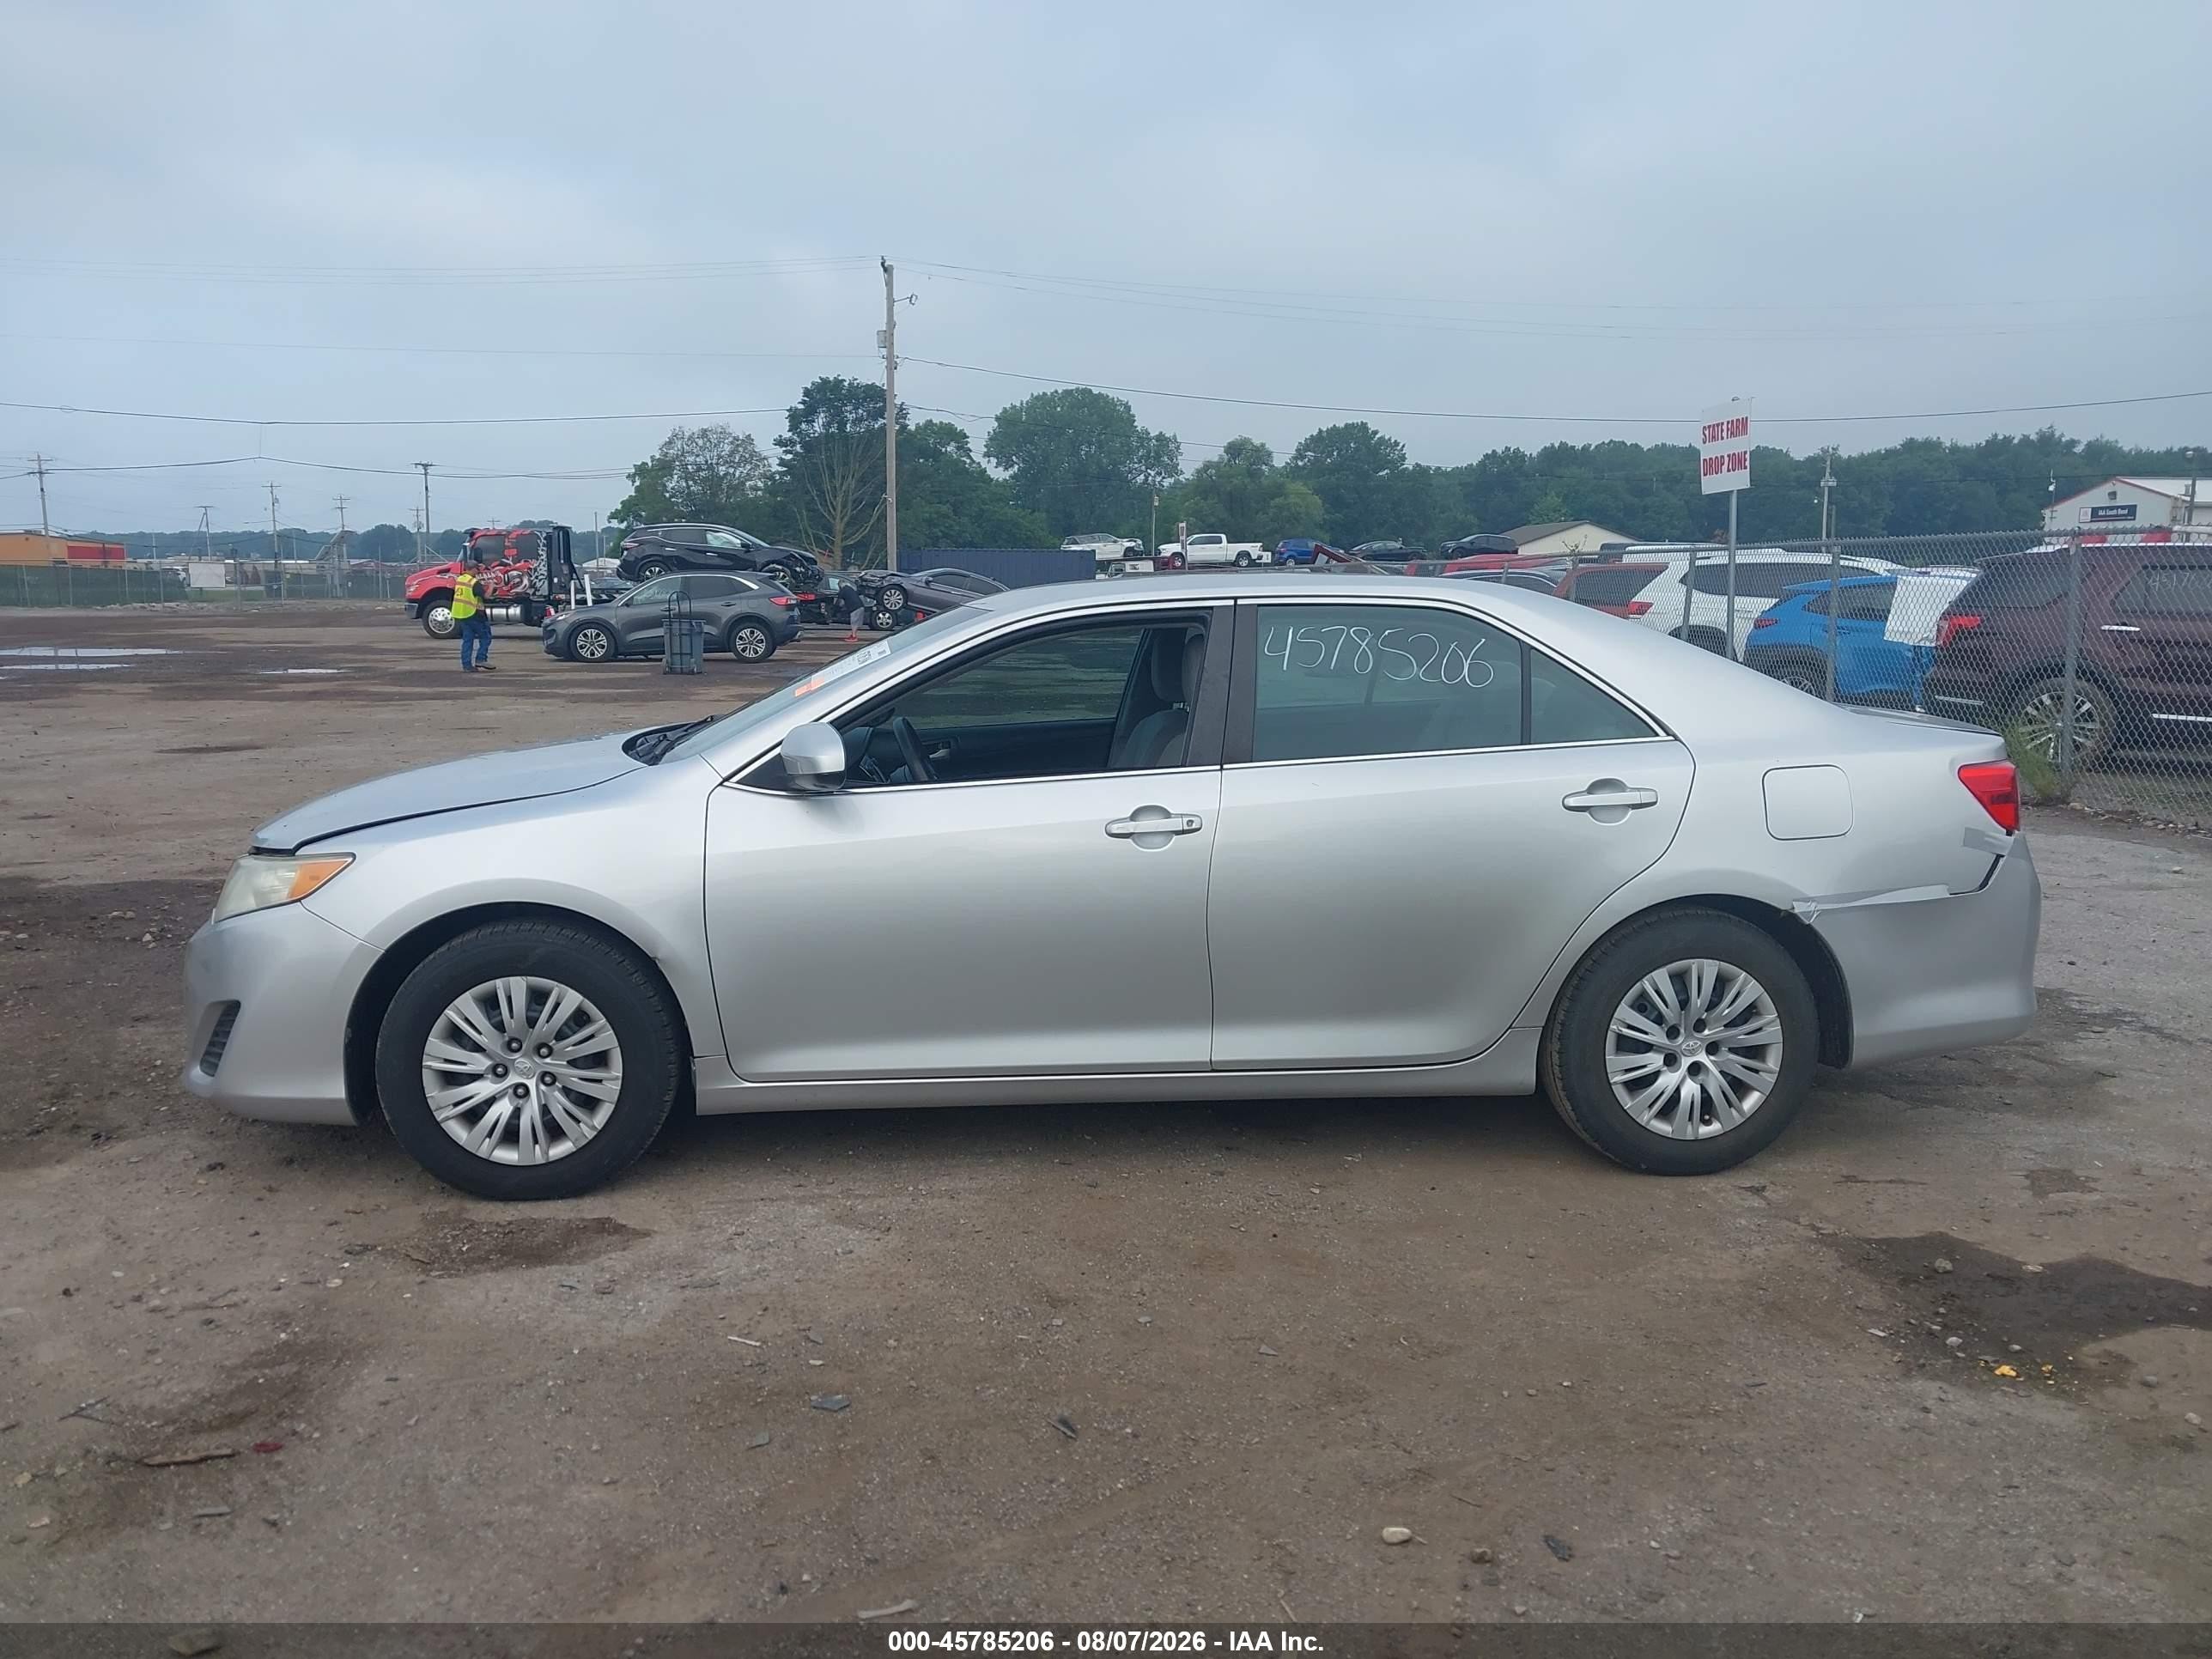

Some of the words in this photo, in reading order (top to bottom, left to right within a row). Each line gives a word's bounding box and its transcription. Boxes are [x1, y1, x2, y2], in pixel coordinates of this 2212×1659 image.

[1702, 421, 1725, 445] STATE
[1726, 416, 1748, 440] FARM
[1703, 455, 1725, 477] DROP
[1727, 450, 1748, 473] ZONE
[1264, 625, 1494, 688] 45785206
